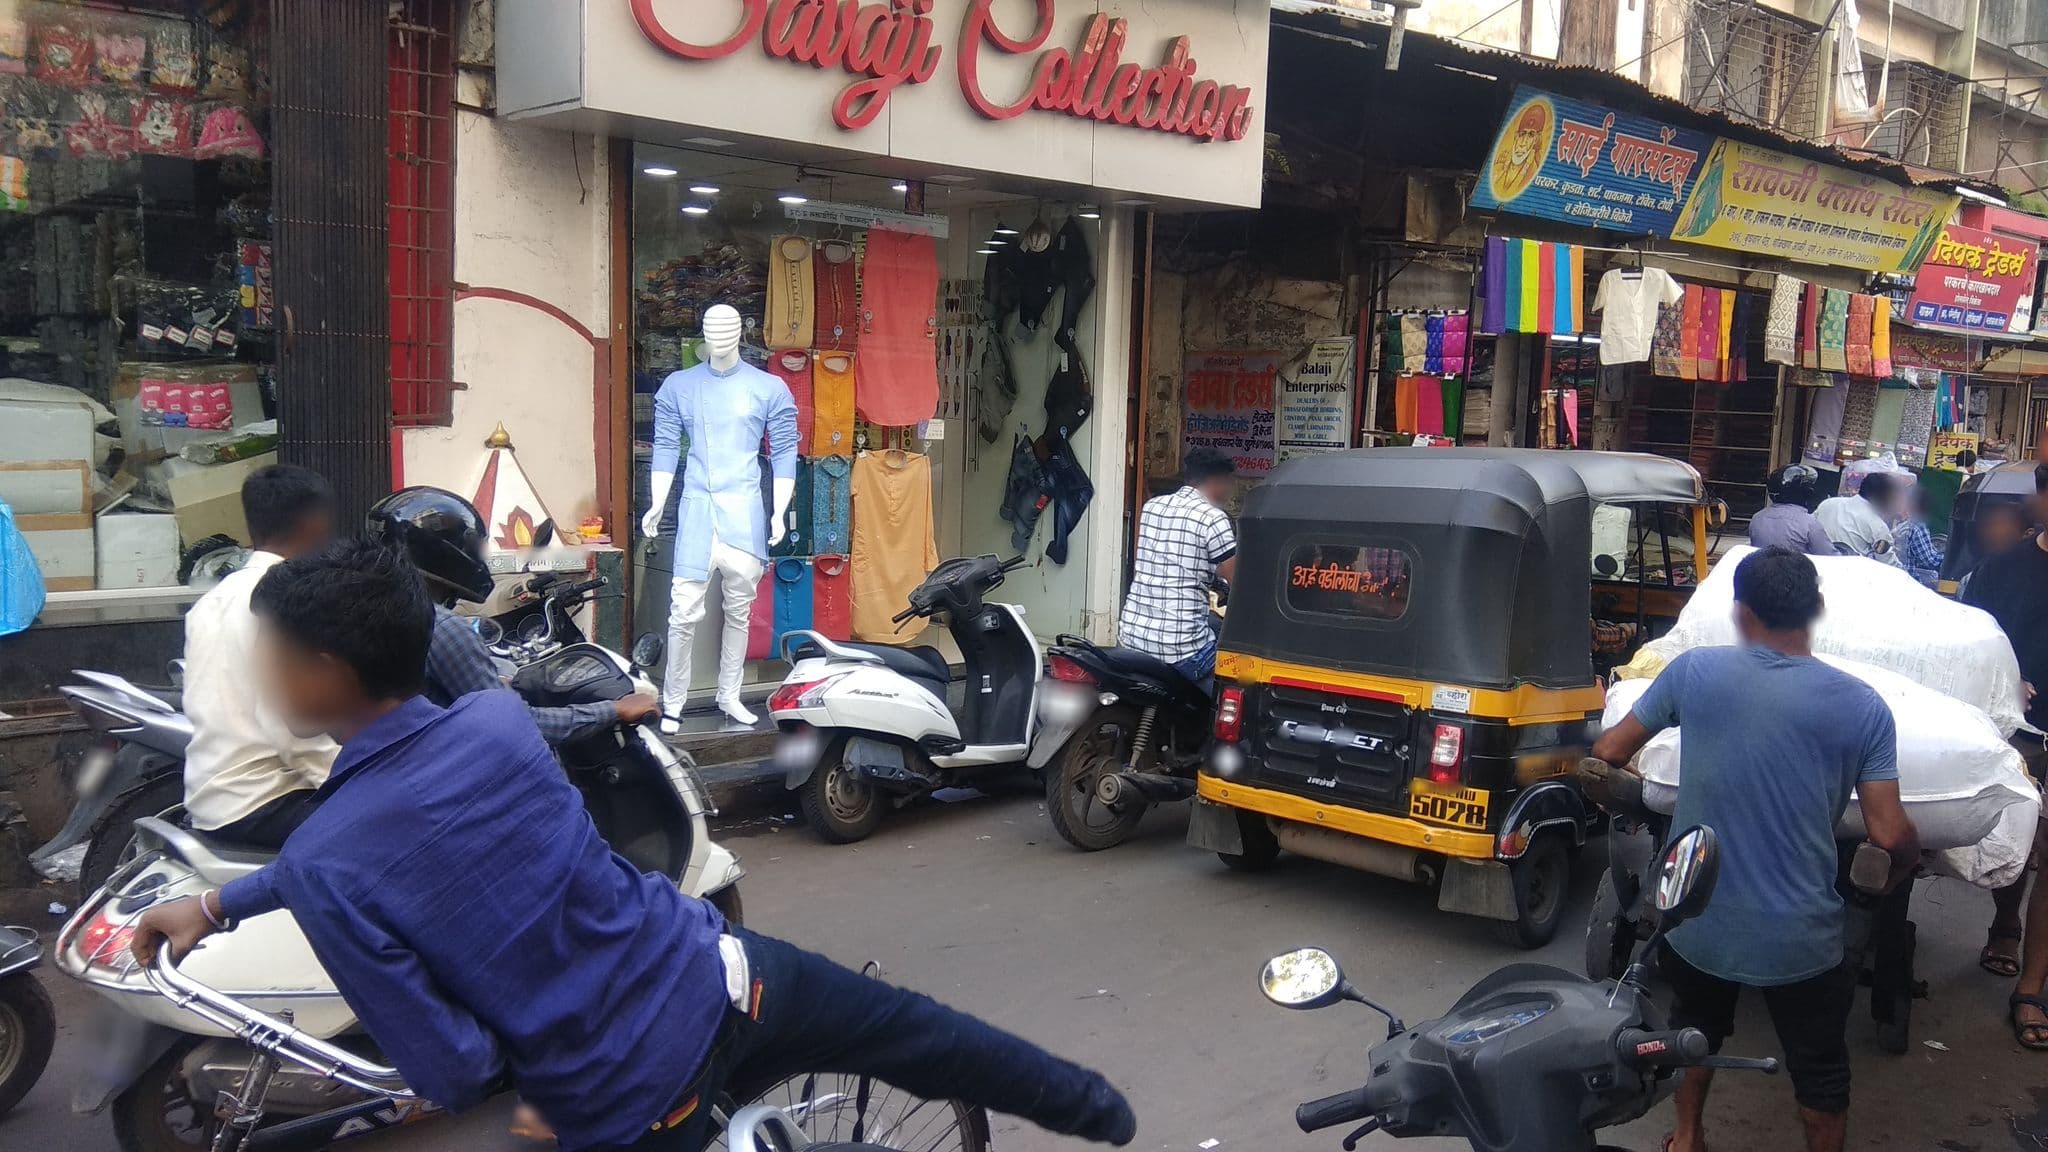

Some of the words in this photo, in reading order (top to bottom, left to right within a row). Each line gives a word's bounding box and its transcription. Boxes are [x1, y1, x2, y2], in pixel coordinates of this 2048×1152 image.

[956, 0, 1255, 142] Collection
[1557, 112, 1615, 178] साई
[1732, 160, 1820, 203] सावजी
[1932, 231, 1985, 268] दिपक
[1983, 240, 2028, 278] ट्रेडर्स
[1301, 362, 1332, 376] Balaji
[1286, 381, 1346, 394] Enterprises
[1935, 450, 1957, 468] ट्रेड
[1412, 794, 1486, 827] 5078
[1637, 1040, 1666, 1055] HONDA
